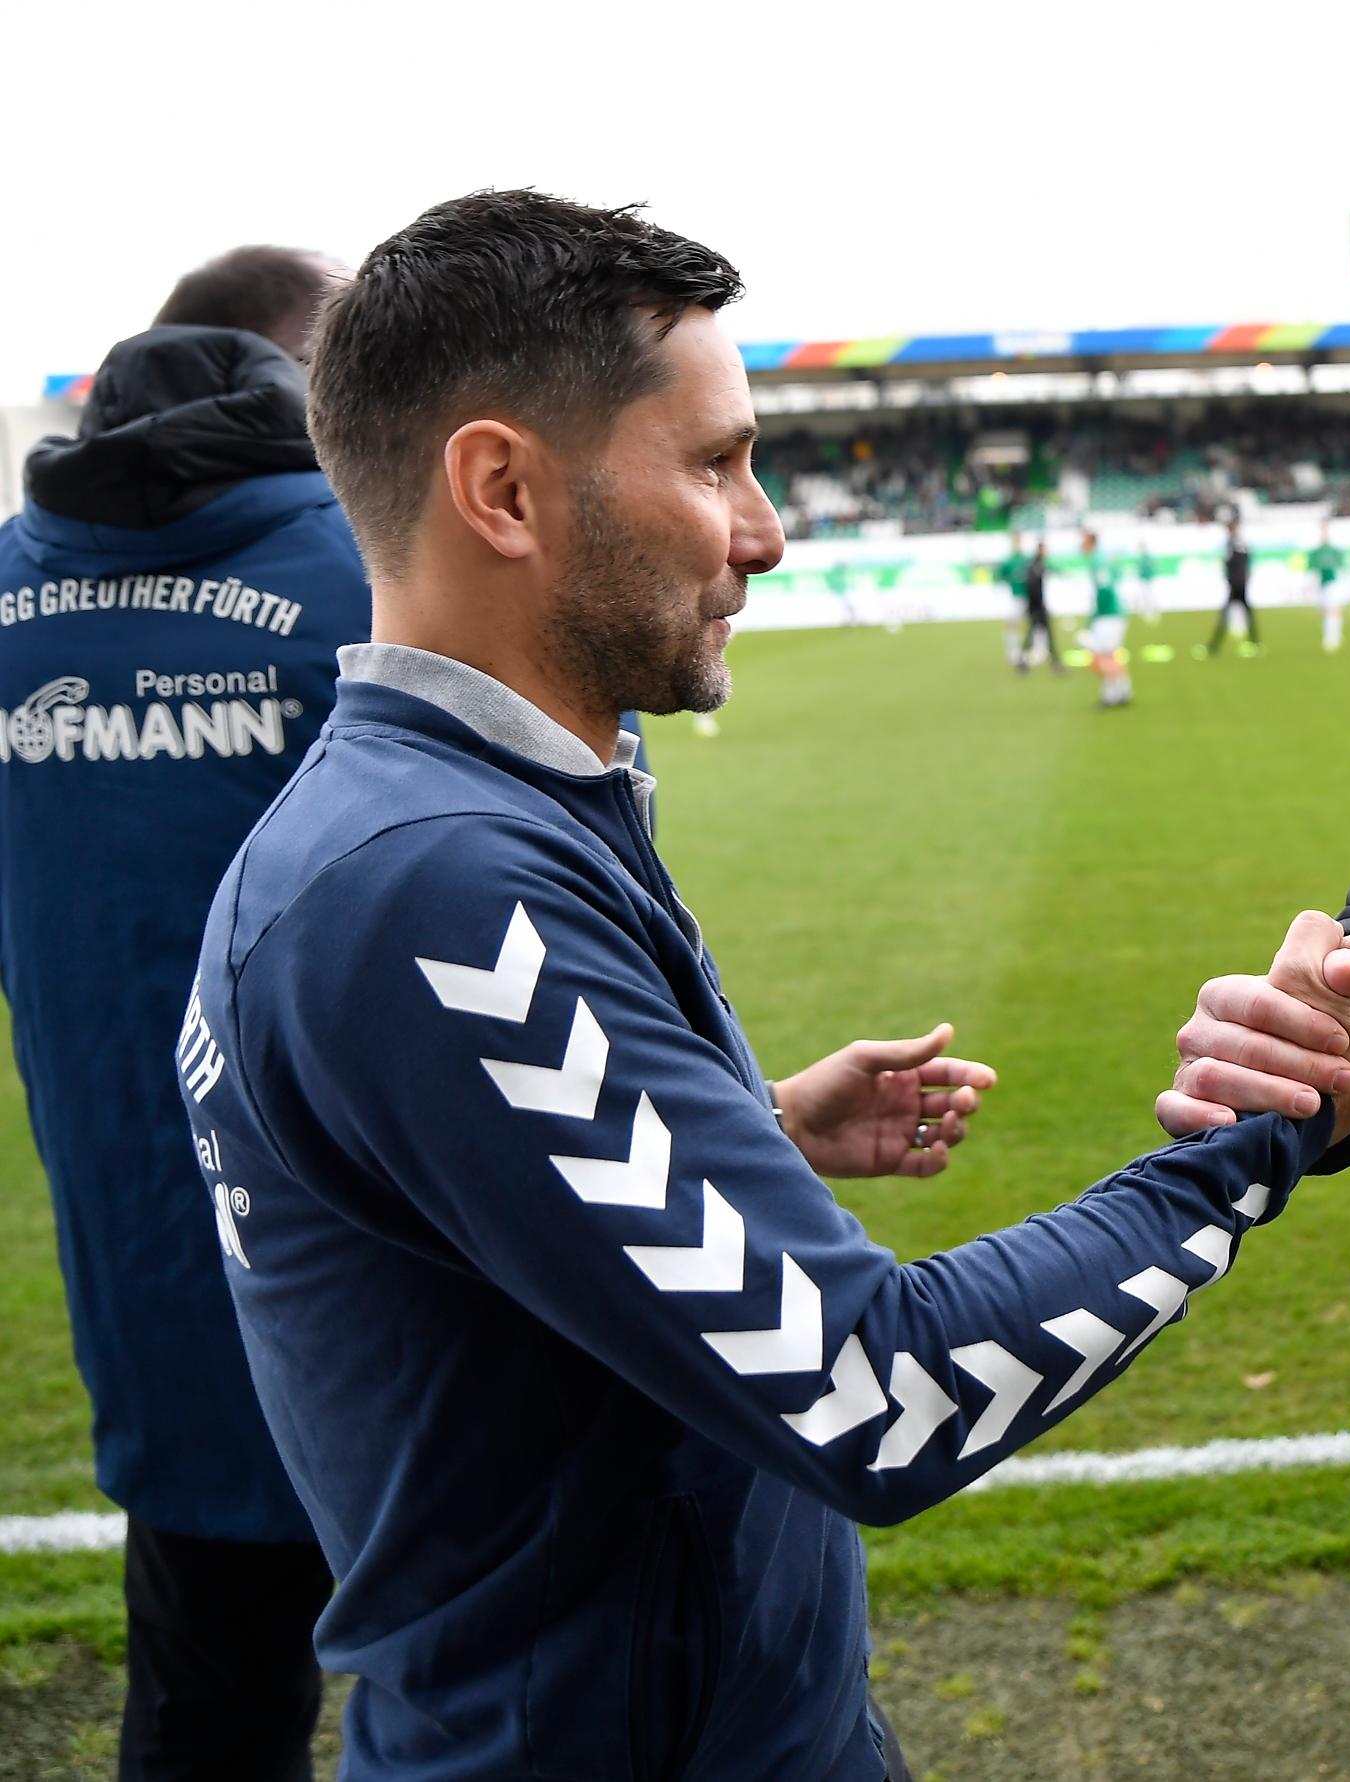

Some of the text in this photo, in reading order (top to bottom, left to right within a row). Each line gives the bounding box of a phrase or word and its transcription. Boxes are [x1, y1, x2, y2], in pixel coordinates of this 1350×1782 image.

[40, 575, 194, 616] GREUTHER
[193, 577, 302, 636] FÜRTH
[136, 664, 278, 697] Personal
[179, 985, 225, 1104] RTH
